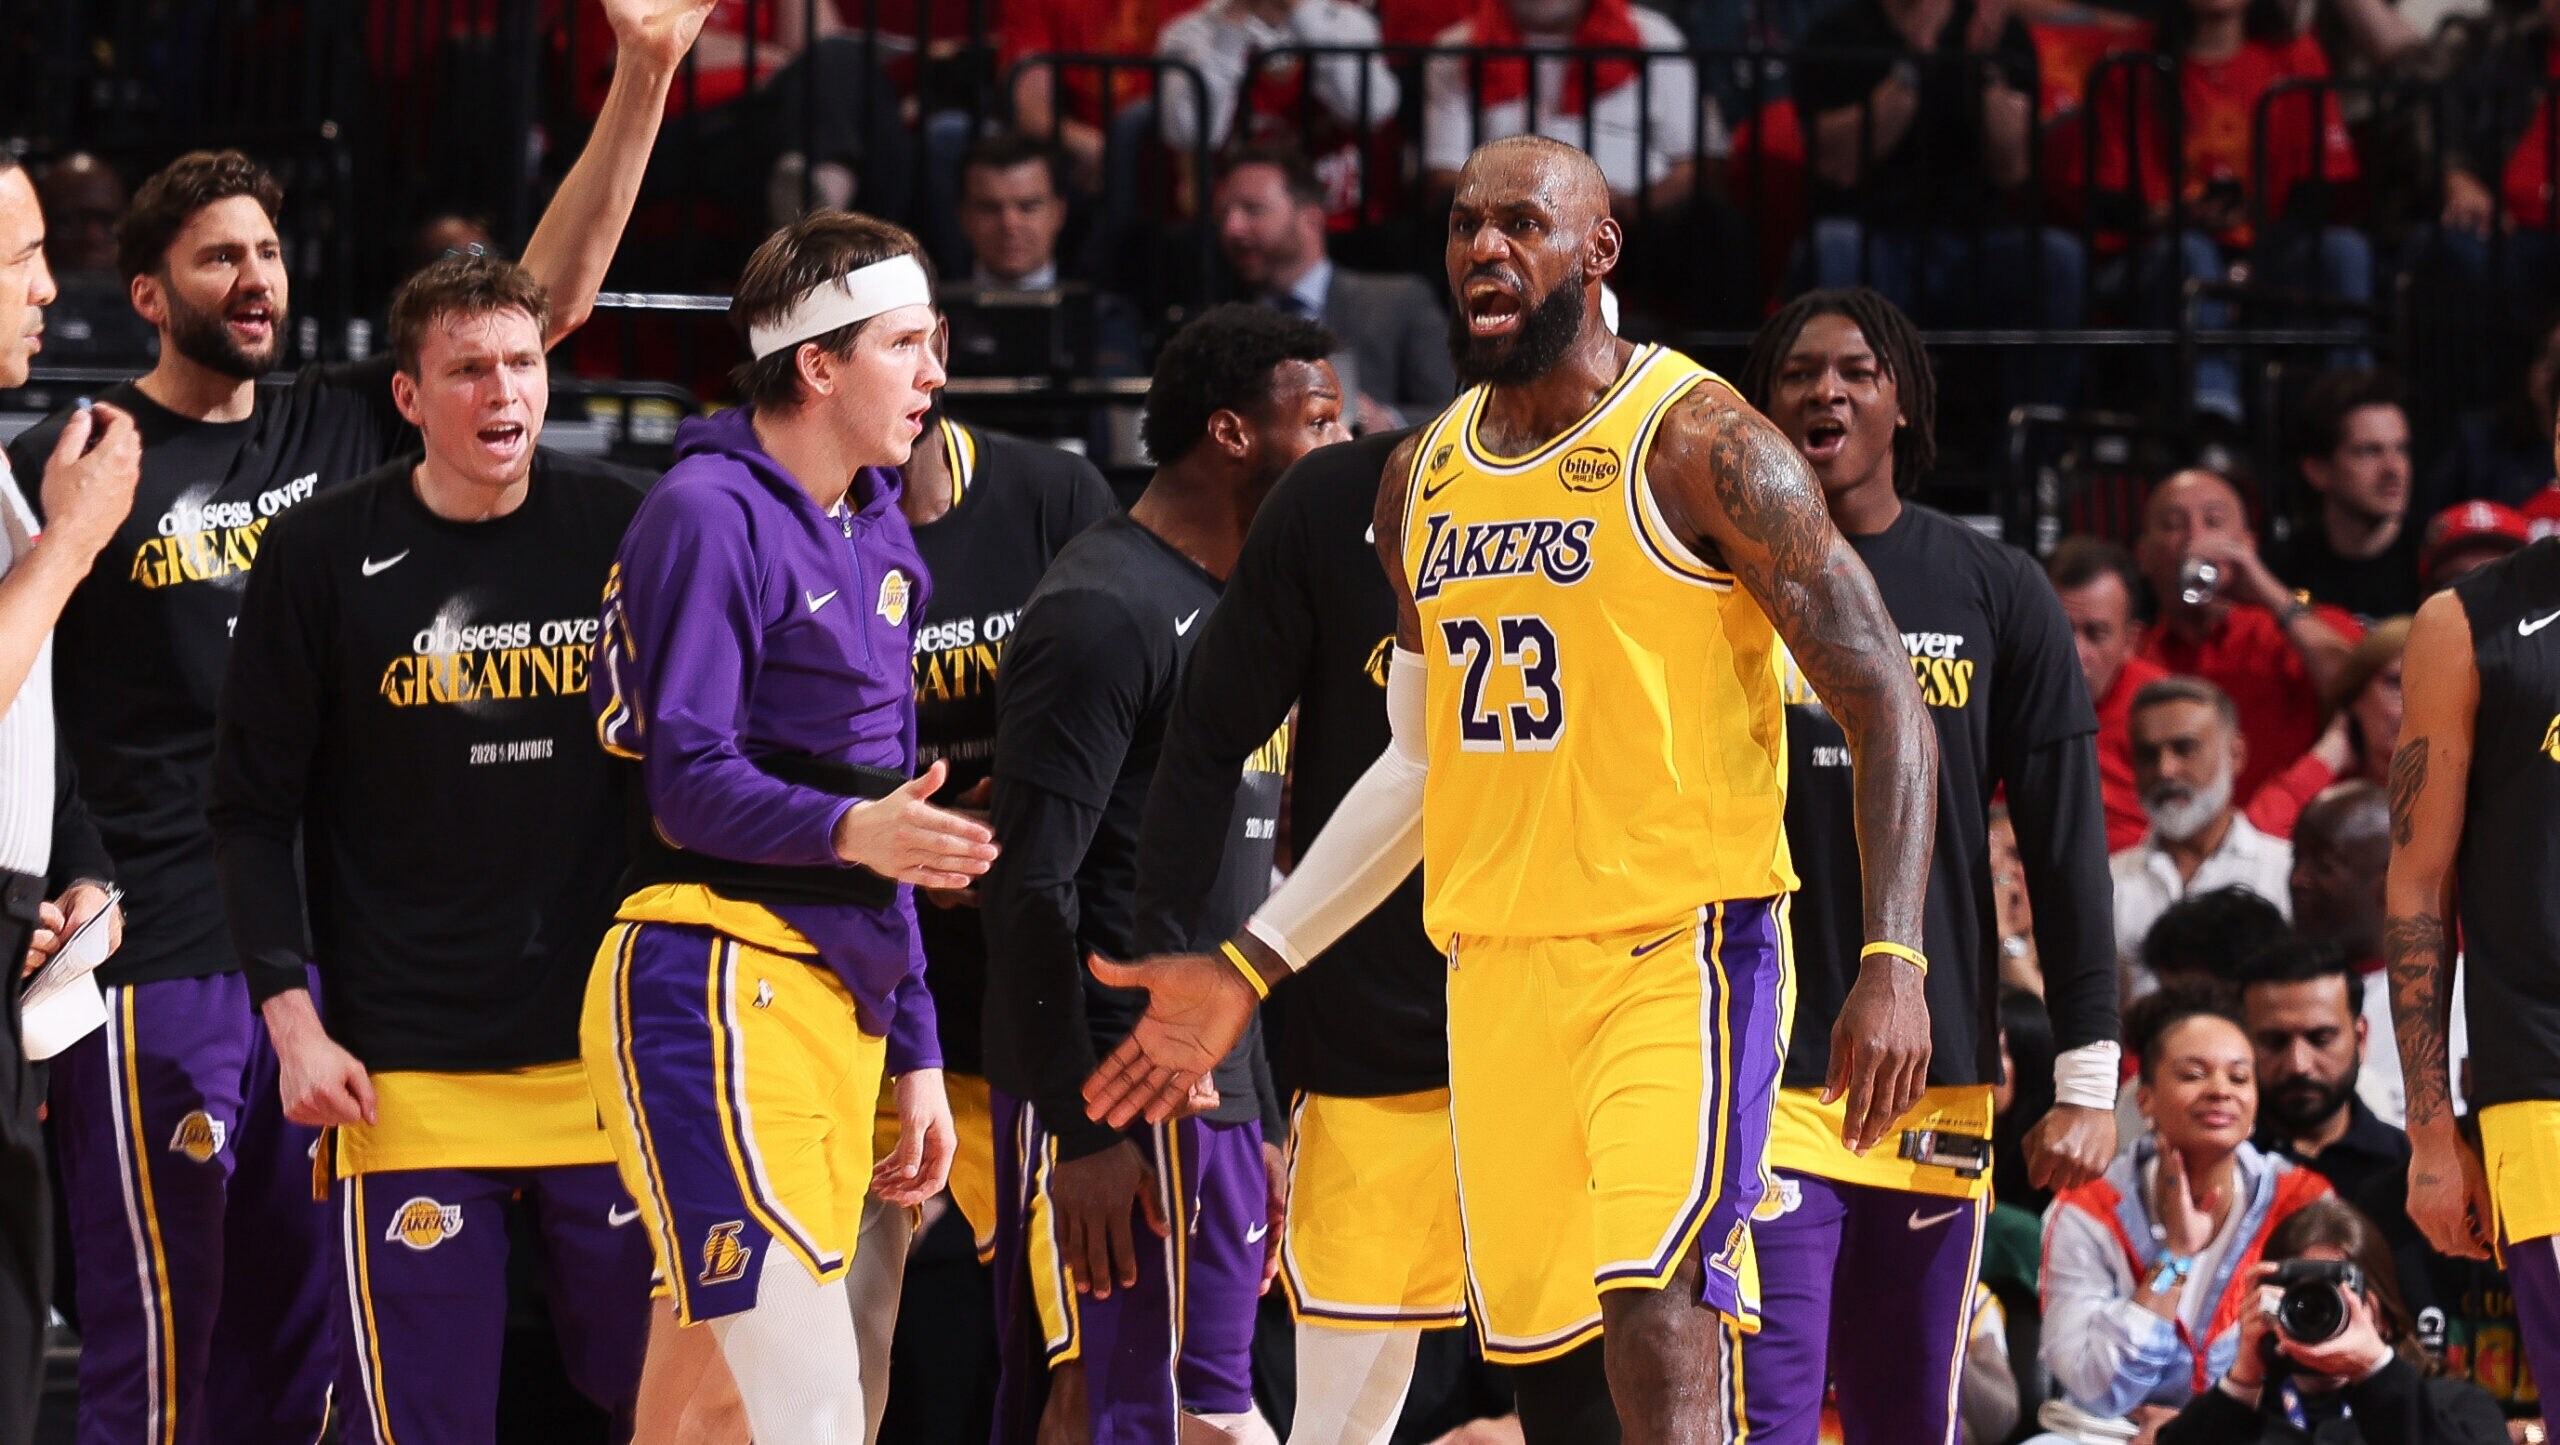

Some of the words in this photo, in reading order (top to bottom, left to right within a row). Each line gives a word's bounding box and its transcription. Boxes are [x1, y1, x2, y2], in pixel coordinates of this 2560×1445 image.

[1565, 457, 1617, 480] bibigo
[158, 501, 254, 537] obsess
[257, 472, 318, 517] over
[1414, 511, 1598, 604] LAKERS
[413, 615, 531, 654] obsess
[539, 617, 600, 647] ove
[1439, 615, 1566, 752] 23
[507, 739, 554, 762] PLAYOFFS
